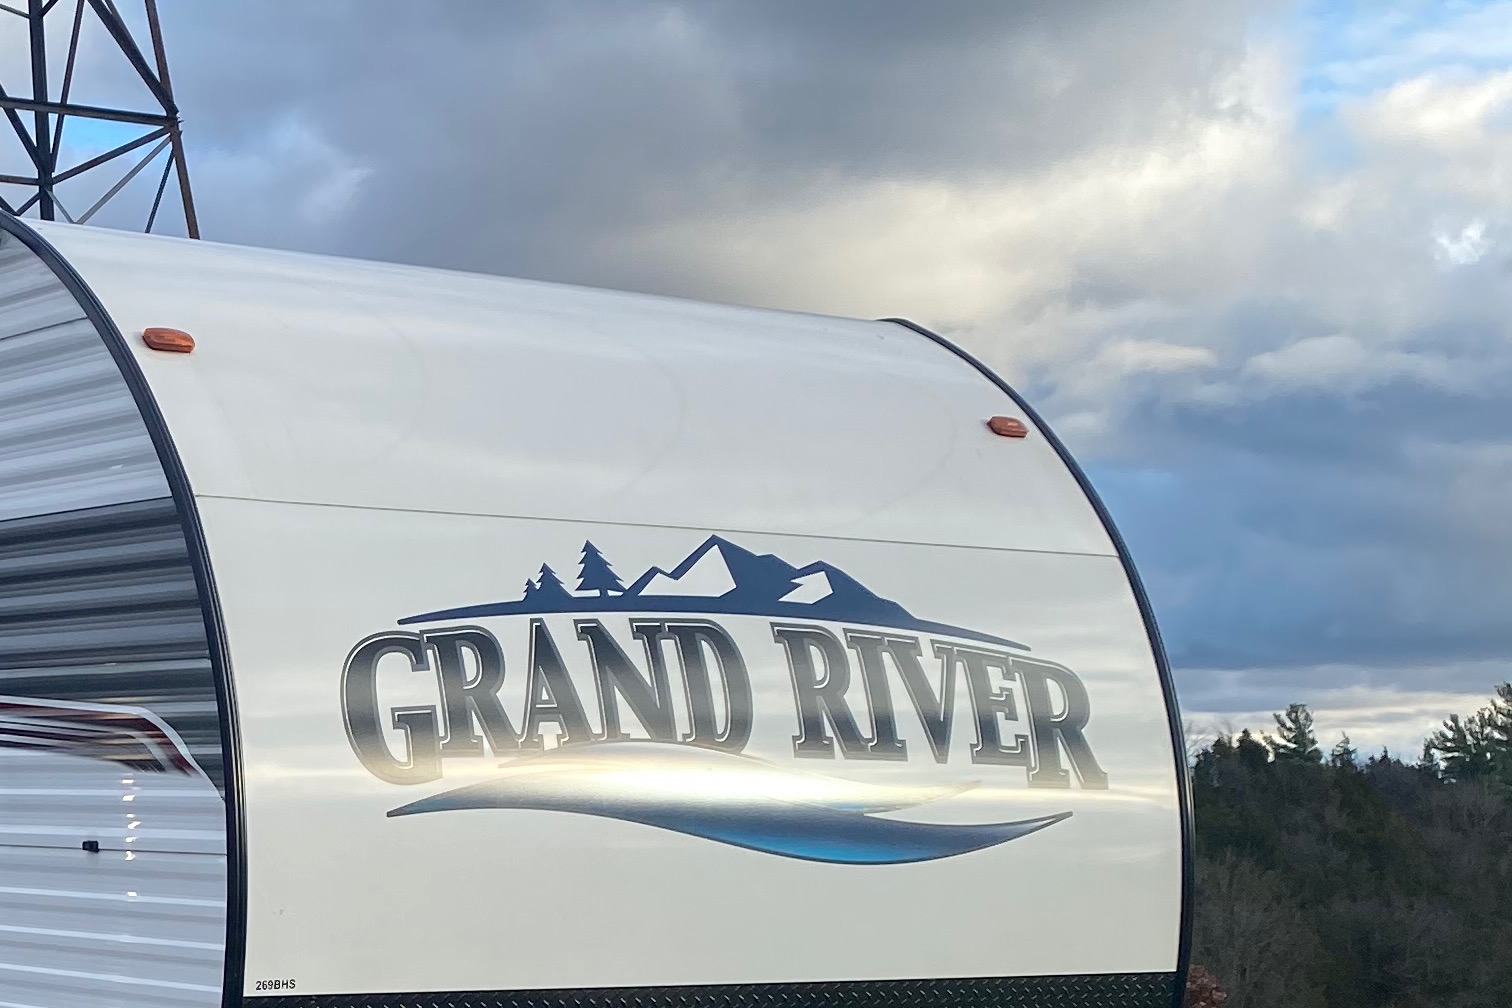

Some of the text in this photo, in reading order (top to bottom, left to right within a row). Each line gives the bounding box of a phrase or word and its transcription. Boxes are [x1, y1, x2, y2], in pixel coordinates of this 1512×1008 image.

[341, 618, 1109, 790] GRAND RIVER
[255, 979, 296, 990] 269BHS
